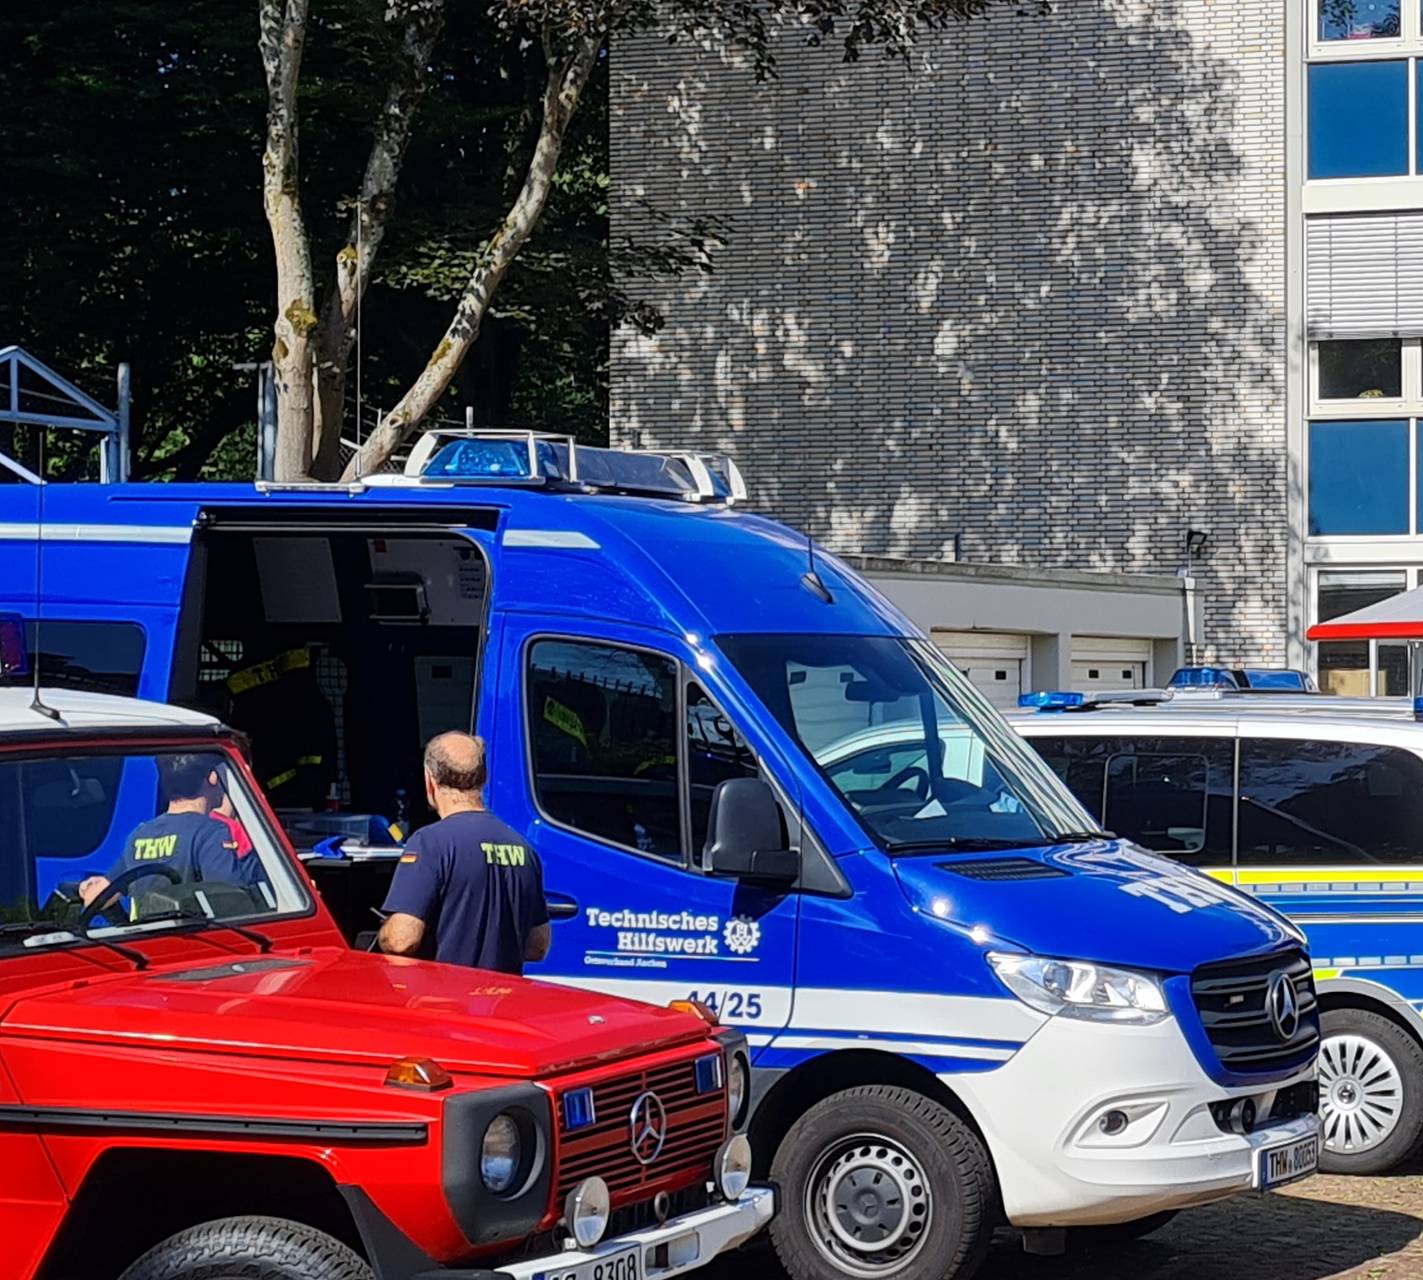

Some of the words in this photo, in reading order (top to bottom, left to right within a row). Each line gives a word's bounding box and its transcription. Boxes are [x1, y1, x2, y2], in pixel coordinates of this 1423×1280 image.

[134, 834, 178, 860] THW
[480, 842, 525, 866] THW
[586, 907, 719, 931] Technisches
[617, 931, 718, 954] Hilfswerk
